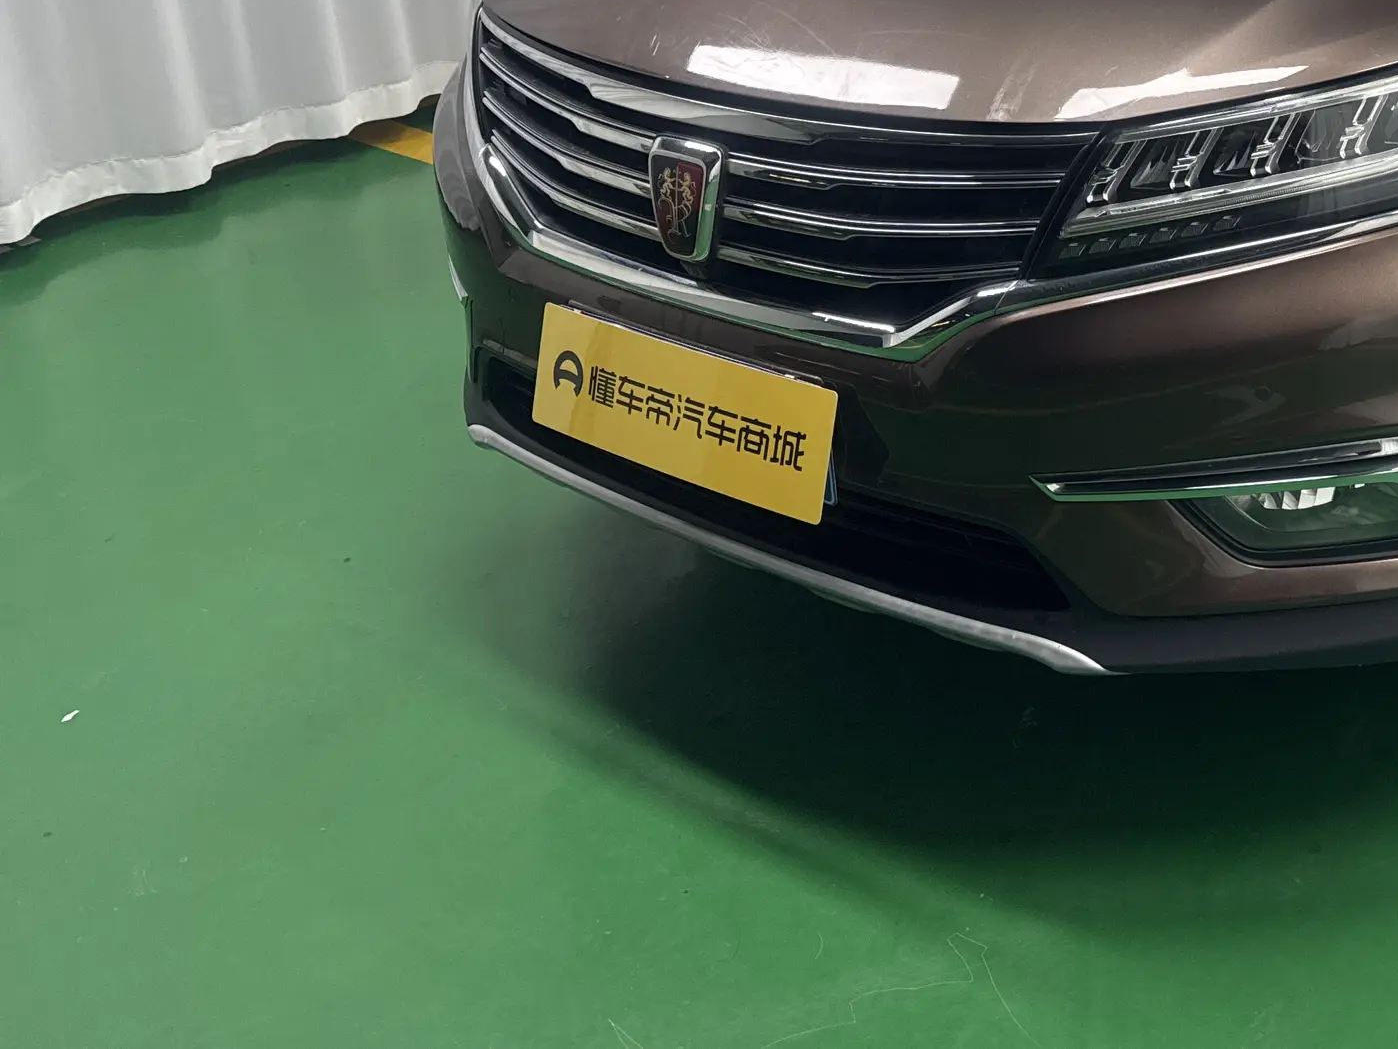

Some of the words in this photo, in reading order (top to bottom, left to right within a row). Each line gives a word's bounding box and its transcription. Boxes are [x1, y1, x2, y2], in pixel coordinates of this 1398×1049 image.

[588, 365, 807, 472] 懂车帝汽车商城
